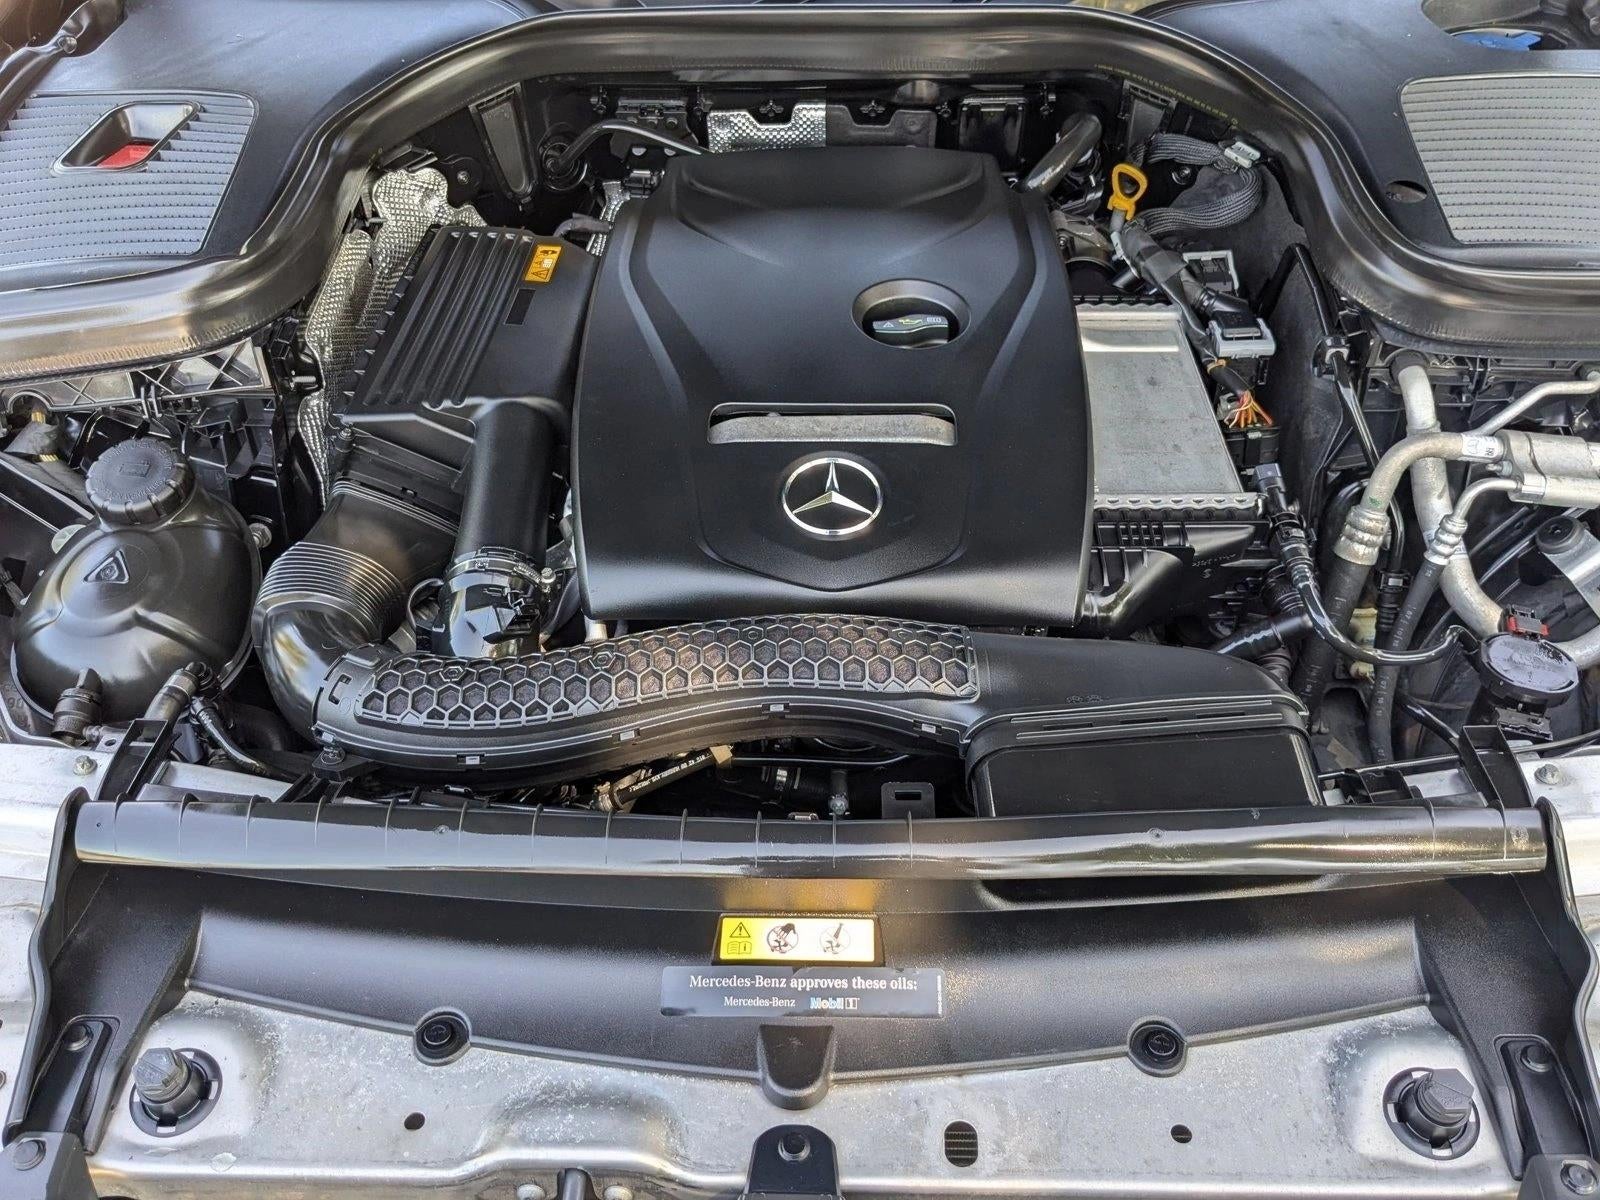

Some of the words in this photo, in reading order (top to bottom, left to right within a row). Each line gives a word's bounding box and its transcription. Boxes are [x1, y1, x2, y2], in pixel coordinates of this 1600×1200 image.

[689, 975, 787, 988] Mercedes-Benz
[790, 977, 848, 991] approves
[851, 976, 887, 989] these
[890, 976, 918, 990] oils:
[723, 996, 796, 1007] Mercedes-Benz
